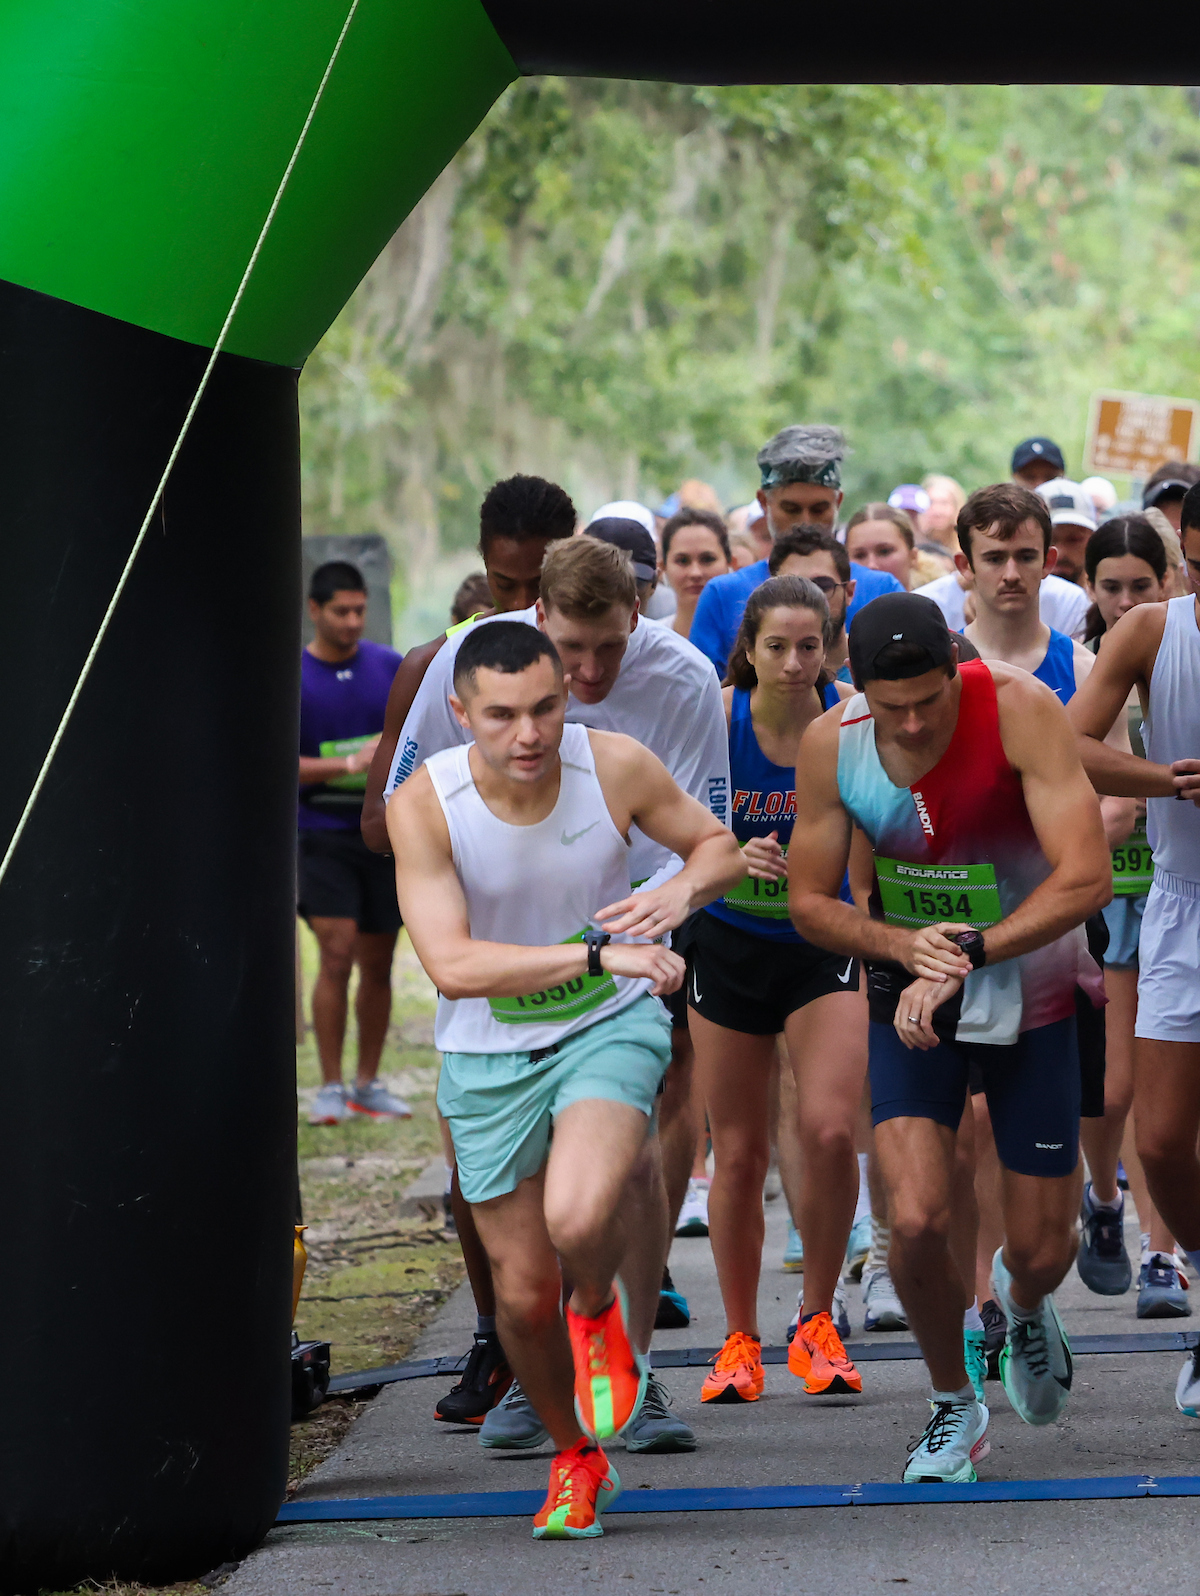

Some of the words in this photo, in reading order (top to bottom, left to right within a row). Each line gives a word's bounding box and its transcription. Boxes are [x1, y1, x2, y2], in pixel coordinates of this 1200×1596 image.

[912, 791, 935, 836] BANDIT
[896, 865, 968, 879] ENDURANCE
[903, 889, 973, 918] 1534
